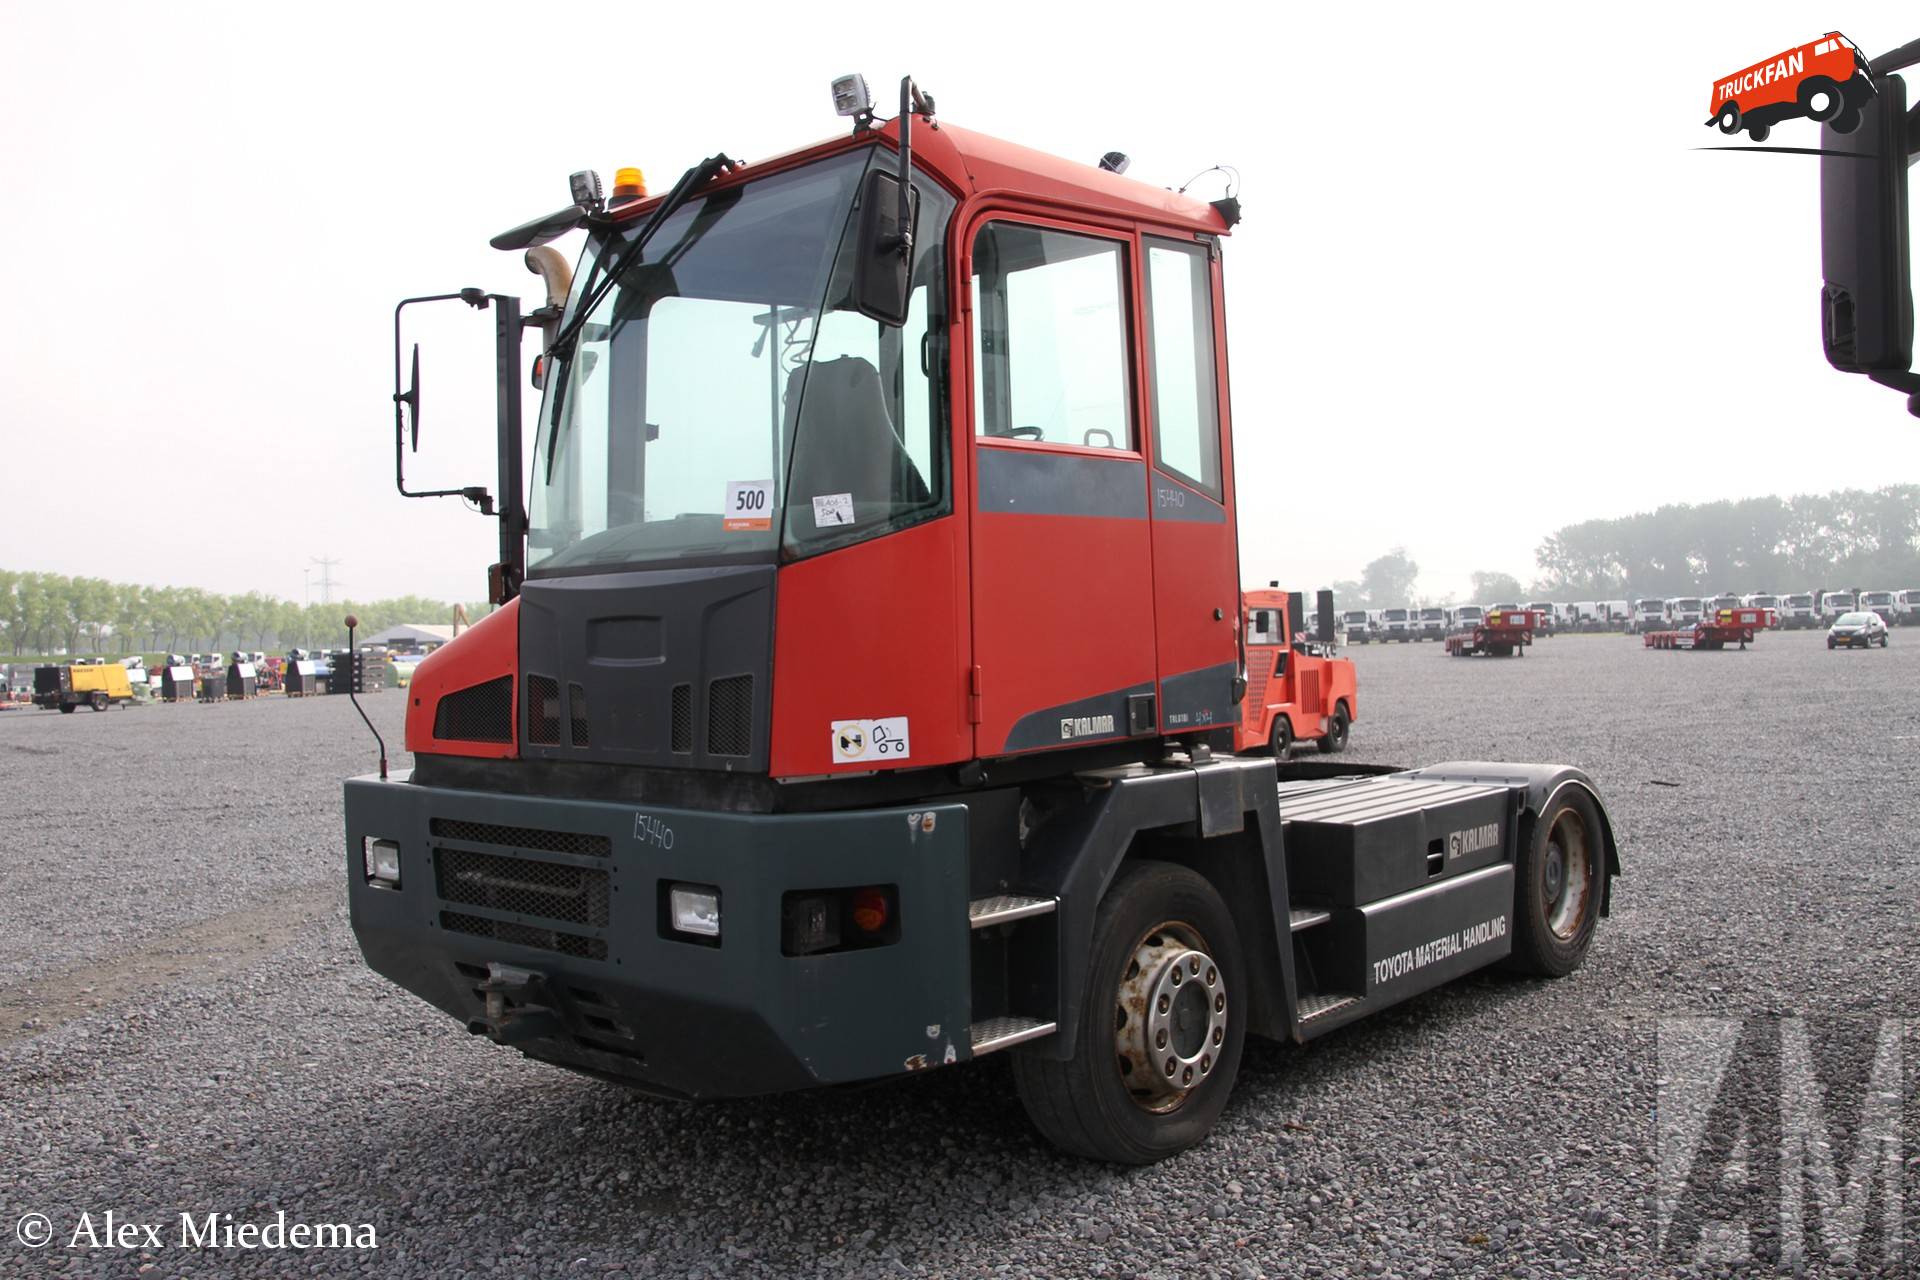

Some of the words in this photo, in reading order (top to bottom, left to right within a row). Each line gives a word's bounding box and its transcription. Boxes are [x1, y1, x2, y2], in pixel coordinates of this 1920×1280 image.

[736, 490, 765, 510] 500
[1157, 488, 1185, 508] 15440
[1074, 714, 1115, 736] KALMAR
[633, 812, 674, 850] 15440
[1462, 823, 1499, 854] KALMAR
[1373, 950, 1414, 984] TOYOTA
[1415, 932, 1462, 969] MATERIAL
[1463, 915, 1506, 950] HANDLING
